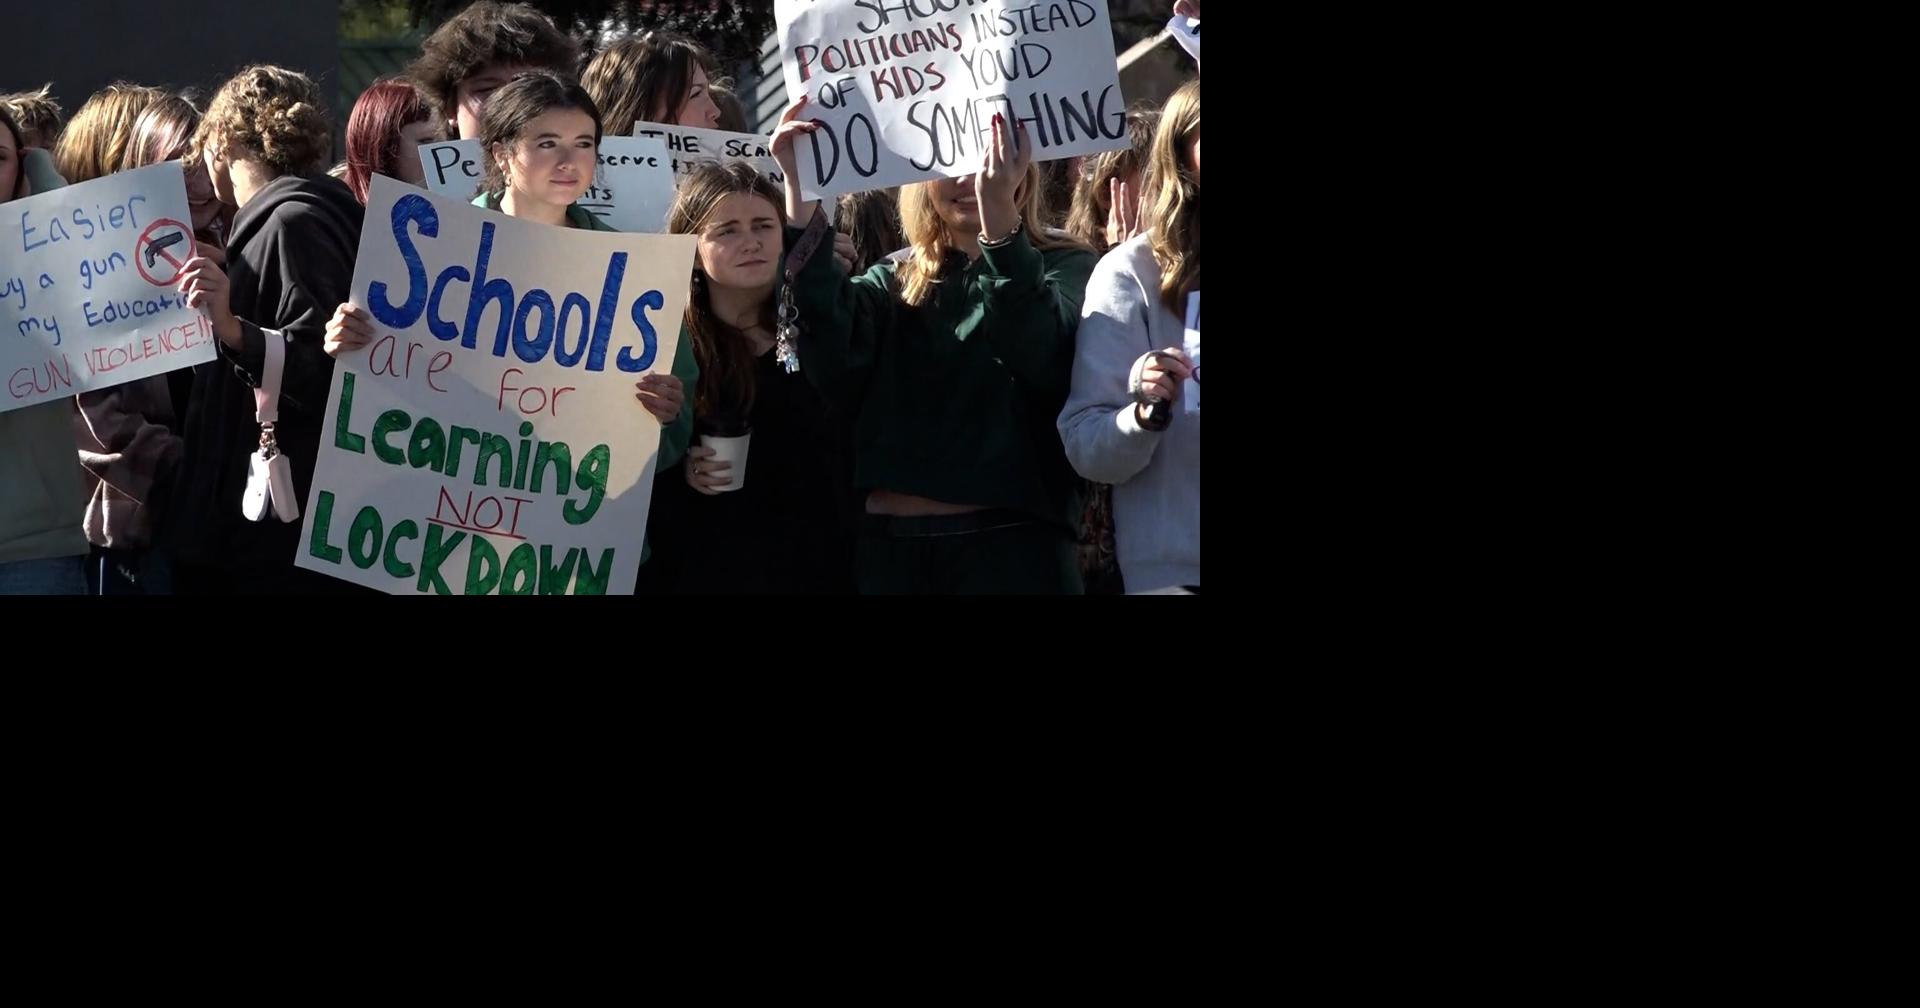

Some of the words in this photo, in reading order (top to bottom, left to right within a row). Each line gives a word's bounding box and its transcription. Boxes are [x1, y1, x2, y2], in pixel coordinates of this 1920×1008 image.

[794, 22, 963, 83] POLITICIANS
[971, 0, 1096, 43] INSTEAD
[817, 76, 857, 110] OF
[871, 61, 946, 103] KIDS
[961, 39, 1051, 90] YOU'D
[807, 112, 878, 187] DO
[22, 195, 146, 252] Easier
[39, 273, 54, 289] a
[79, 250, 126, 290] gun
[367, 193, 664, 373] Schools
[18, 314, 61, 346] my
[8, 353, 72, 399] GUN
[369, 334, 452, 392] are
[334, 371, 611, 525] Learning
[310, 490, 615, 595] LOCKDOWN
[435, 485, 534, 538] NOT
